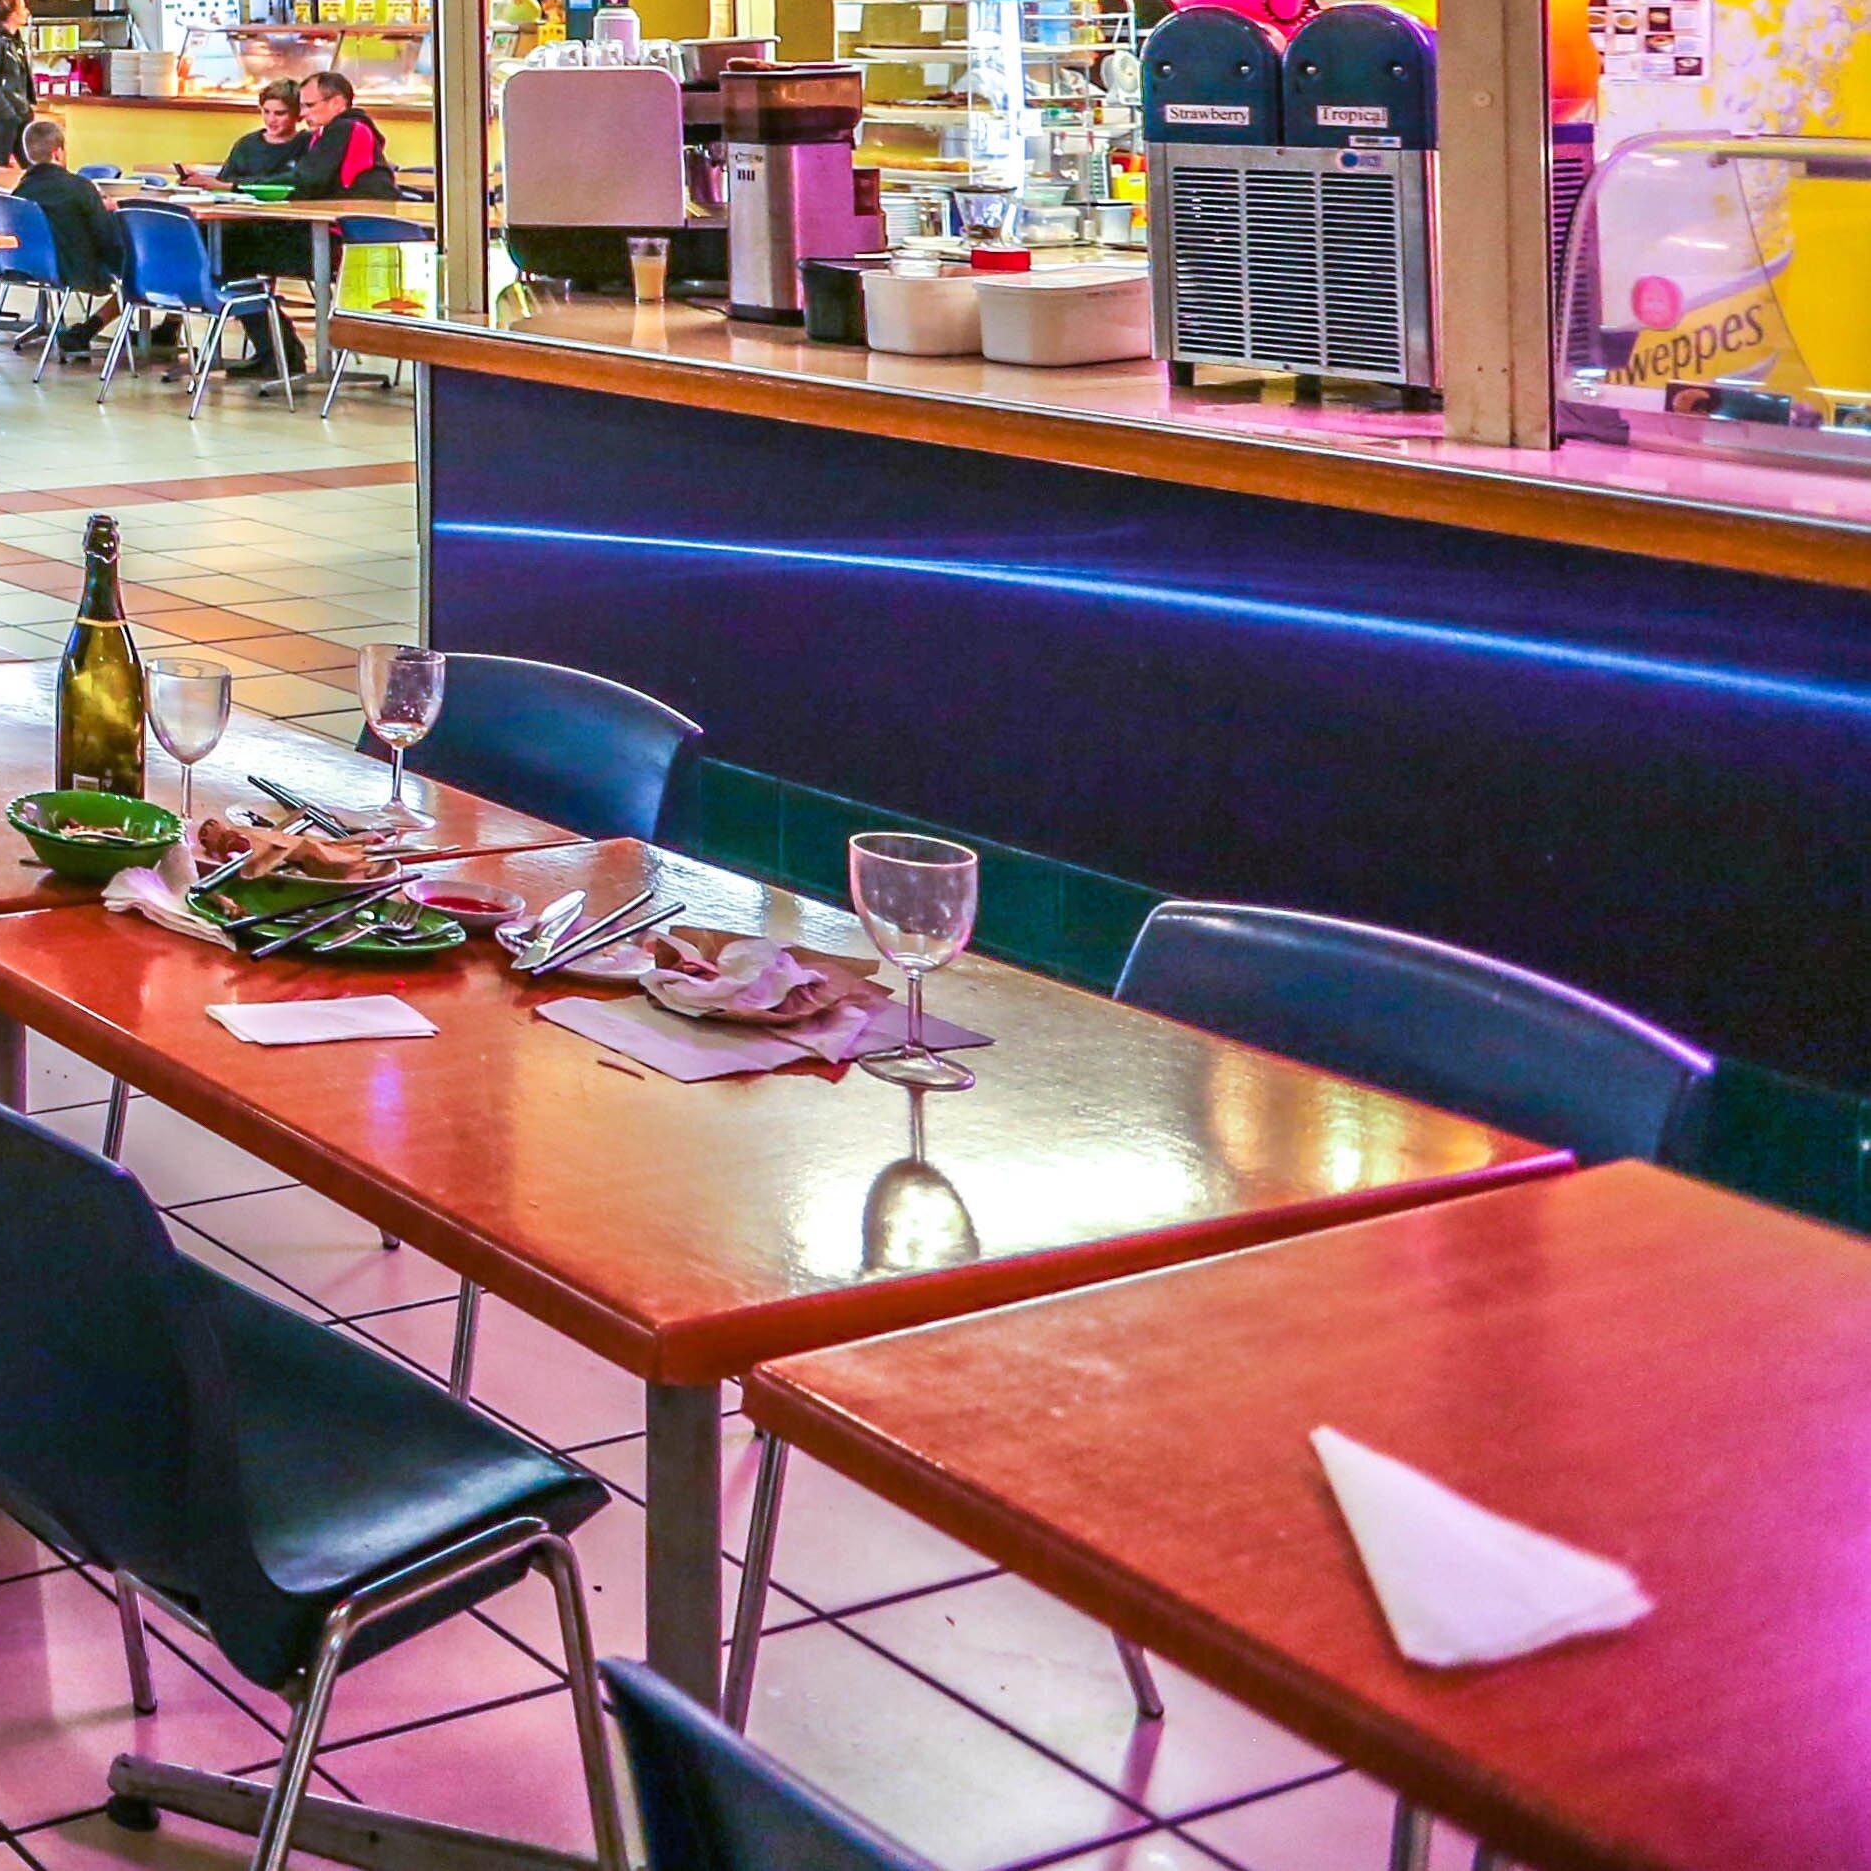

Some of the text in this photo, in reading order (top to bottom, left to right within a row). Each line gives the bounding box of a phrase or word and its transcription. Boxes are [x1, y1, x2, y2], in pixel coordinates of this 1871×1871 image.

[1168, 106, 1247, 123] Strawberry
[1320, 105, 1388, 123] Tropical
[1606, 304, 1765, 385] weppes
